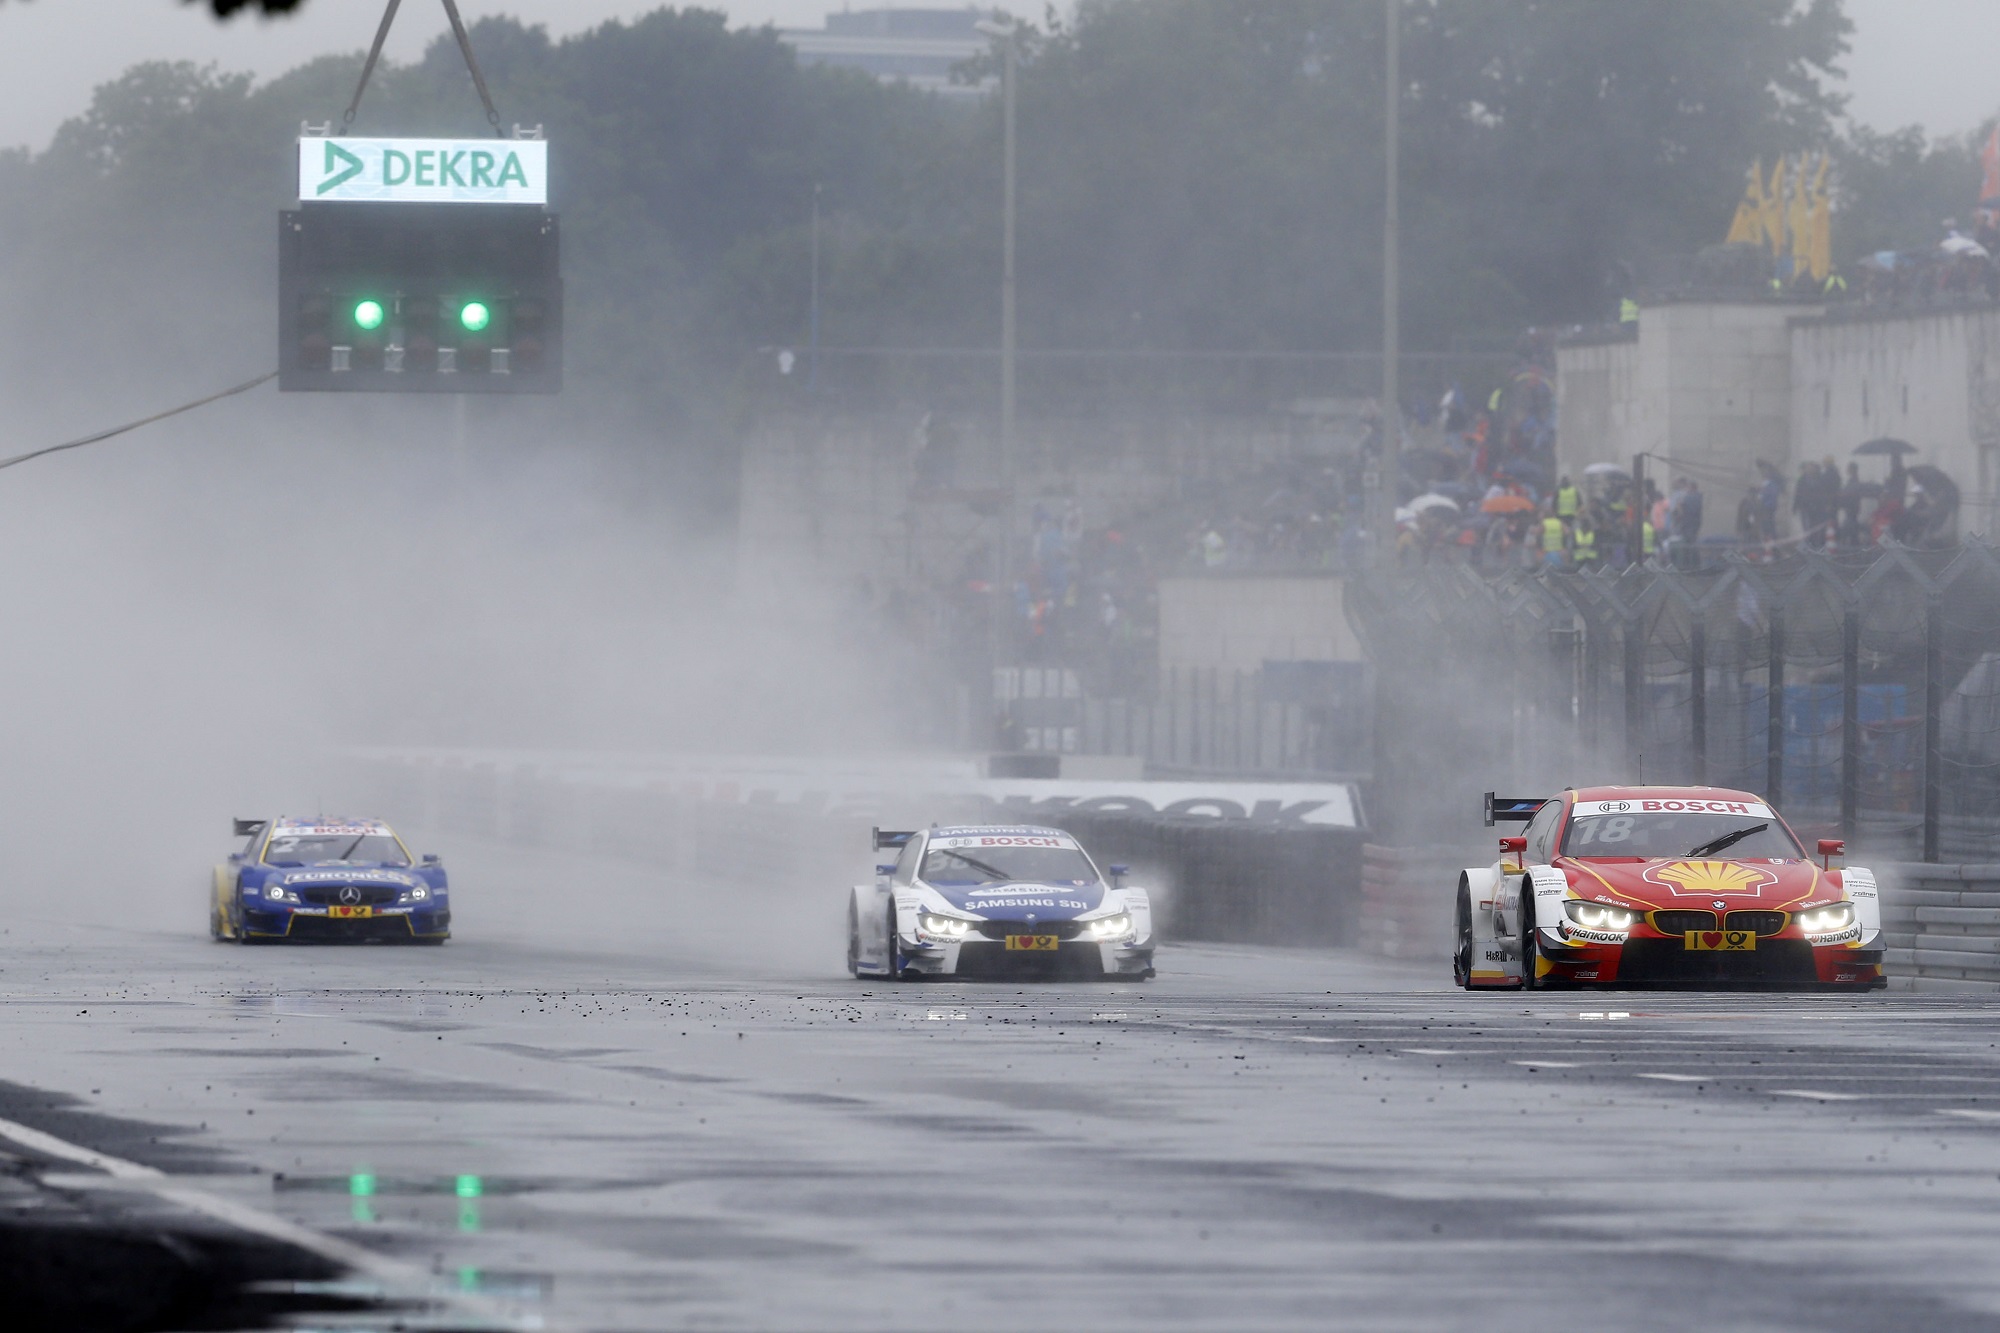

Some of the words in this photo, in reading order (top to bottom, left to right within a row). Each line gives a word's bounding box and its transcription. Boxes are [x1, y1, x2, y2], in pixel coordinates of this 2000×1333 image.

[383, 149, 529, 188] DEKRA
[1642, 800, 1750, 814] BOSCH
[939, 828, 1027, 836] SAMSUNG
[1031, 828, 1061, 837] SDI
[1577, 816, 1637, 845] 18
[981, 837, 1060, 847] BOSCH
[964, 899, 1055, 911] SAMSUNG
[1059, 899, 1088, 911] SDI
[1693, 931, 1698, 949] I
